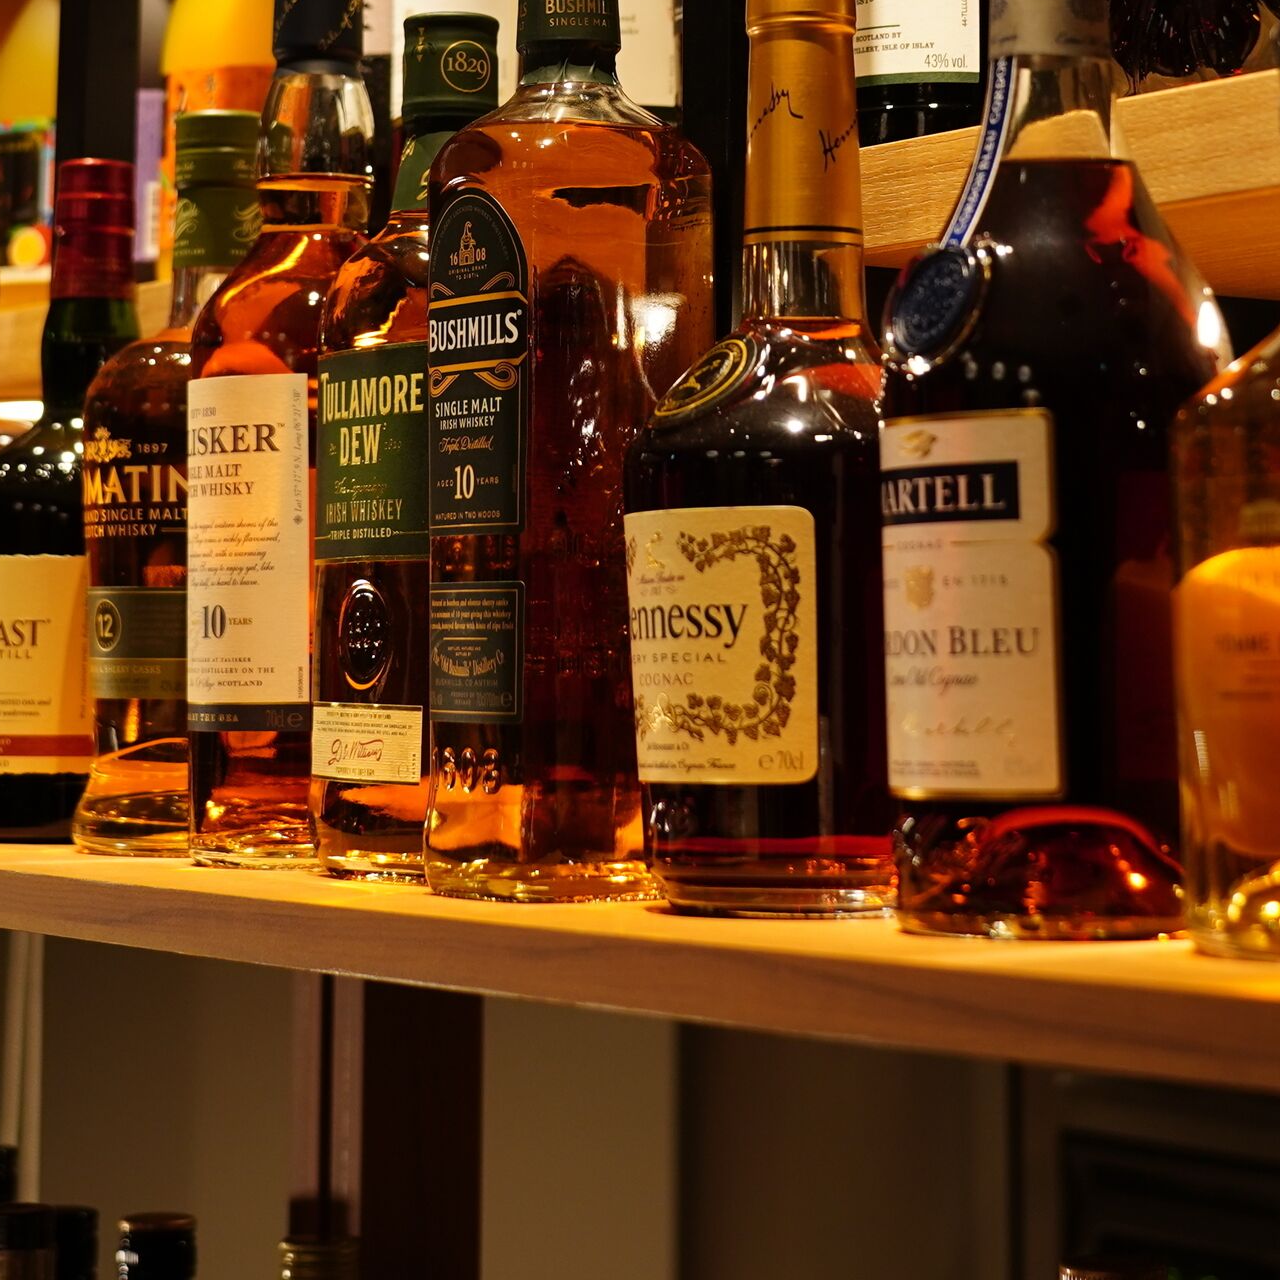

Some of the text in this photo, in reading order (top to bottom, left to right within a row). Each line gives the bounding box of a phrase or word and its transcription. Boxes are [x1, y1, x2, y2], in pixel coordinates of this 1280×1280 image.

[549, 17, 589, 28] SINGLE
[855, 32, 902, 43] SCOTLAND BY
[882, 41, 935, 52] ISLE OF ISLAY
[447, 51, 488, 81] 1829
[924, 53, 968, 70] 43% vol.
[450, 247, 487, 266] 16 08
[321, 372, 424, 425] TULLAMORE
[435, 396, 503, 418] SINGLE MALT
[440, 415, 495, 431] IRISH WHISKEY
[138, 443, 168, 455] 1897
[439, 435, 494, 455] Triple Distilled
[205, 463, 242, 479] MALT
[200, 481, 254, 497] WHISKY
[436, 464, 500, 500] AGED 10 YEARS
[101, 507, 189, 522] SINGLE MALT
[326, 498, 403, 525] IRISH WHISKEY
[435, 512, 457, 521] MATURED
[465, 510, 477, 519] TWO
[478, 509, 501, 519] WOODS
[108, 523, 157, 537] WHISKY
[242, 531, 280, 545] flavoured,
[330, 527, 393, 541] TRIPLE DISTILLED
[234, 551, 266, 561] warming
[261, 561, 275, 571] like
[98, 614, 113, 638] 12
[202, 604, 226, 639] 10
[948, 625, 1040, 657] BLEU
[652, 652, 726, 663] SPECIAL
[639, 672, 694, 687] COGNAC
